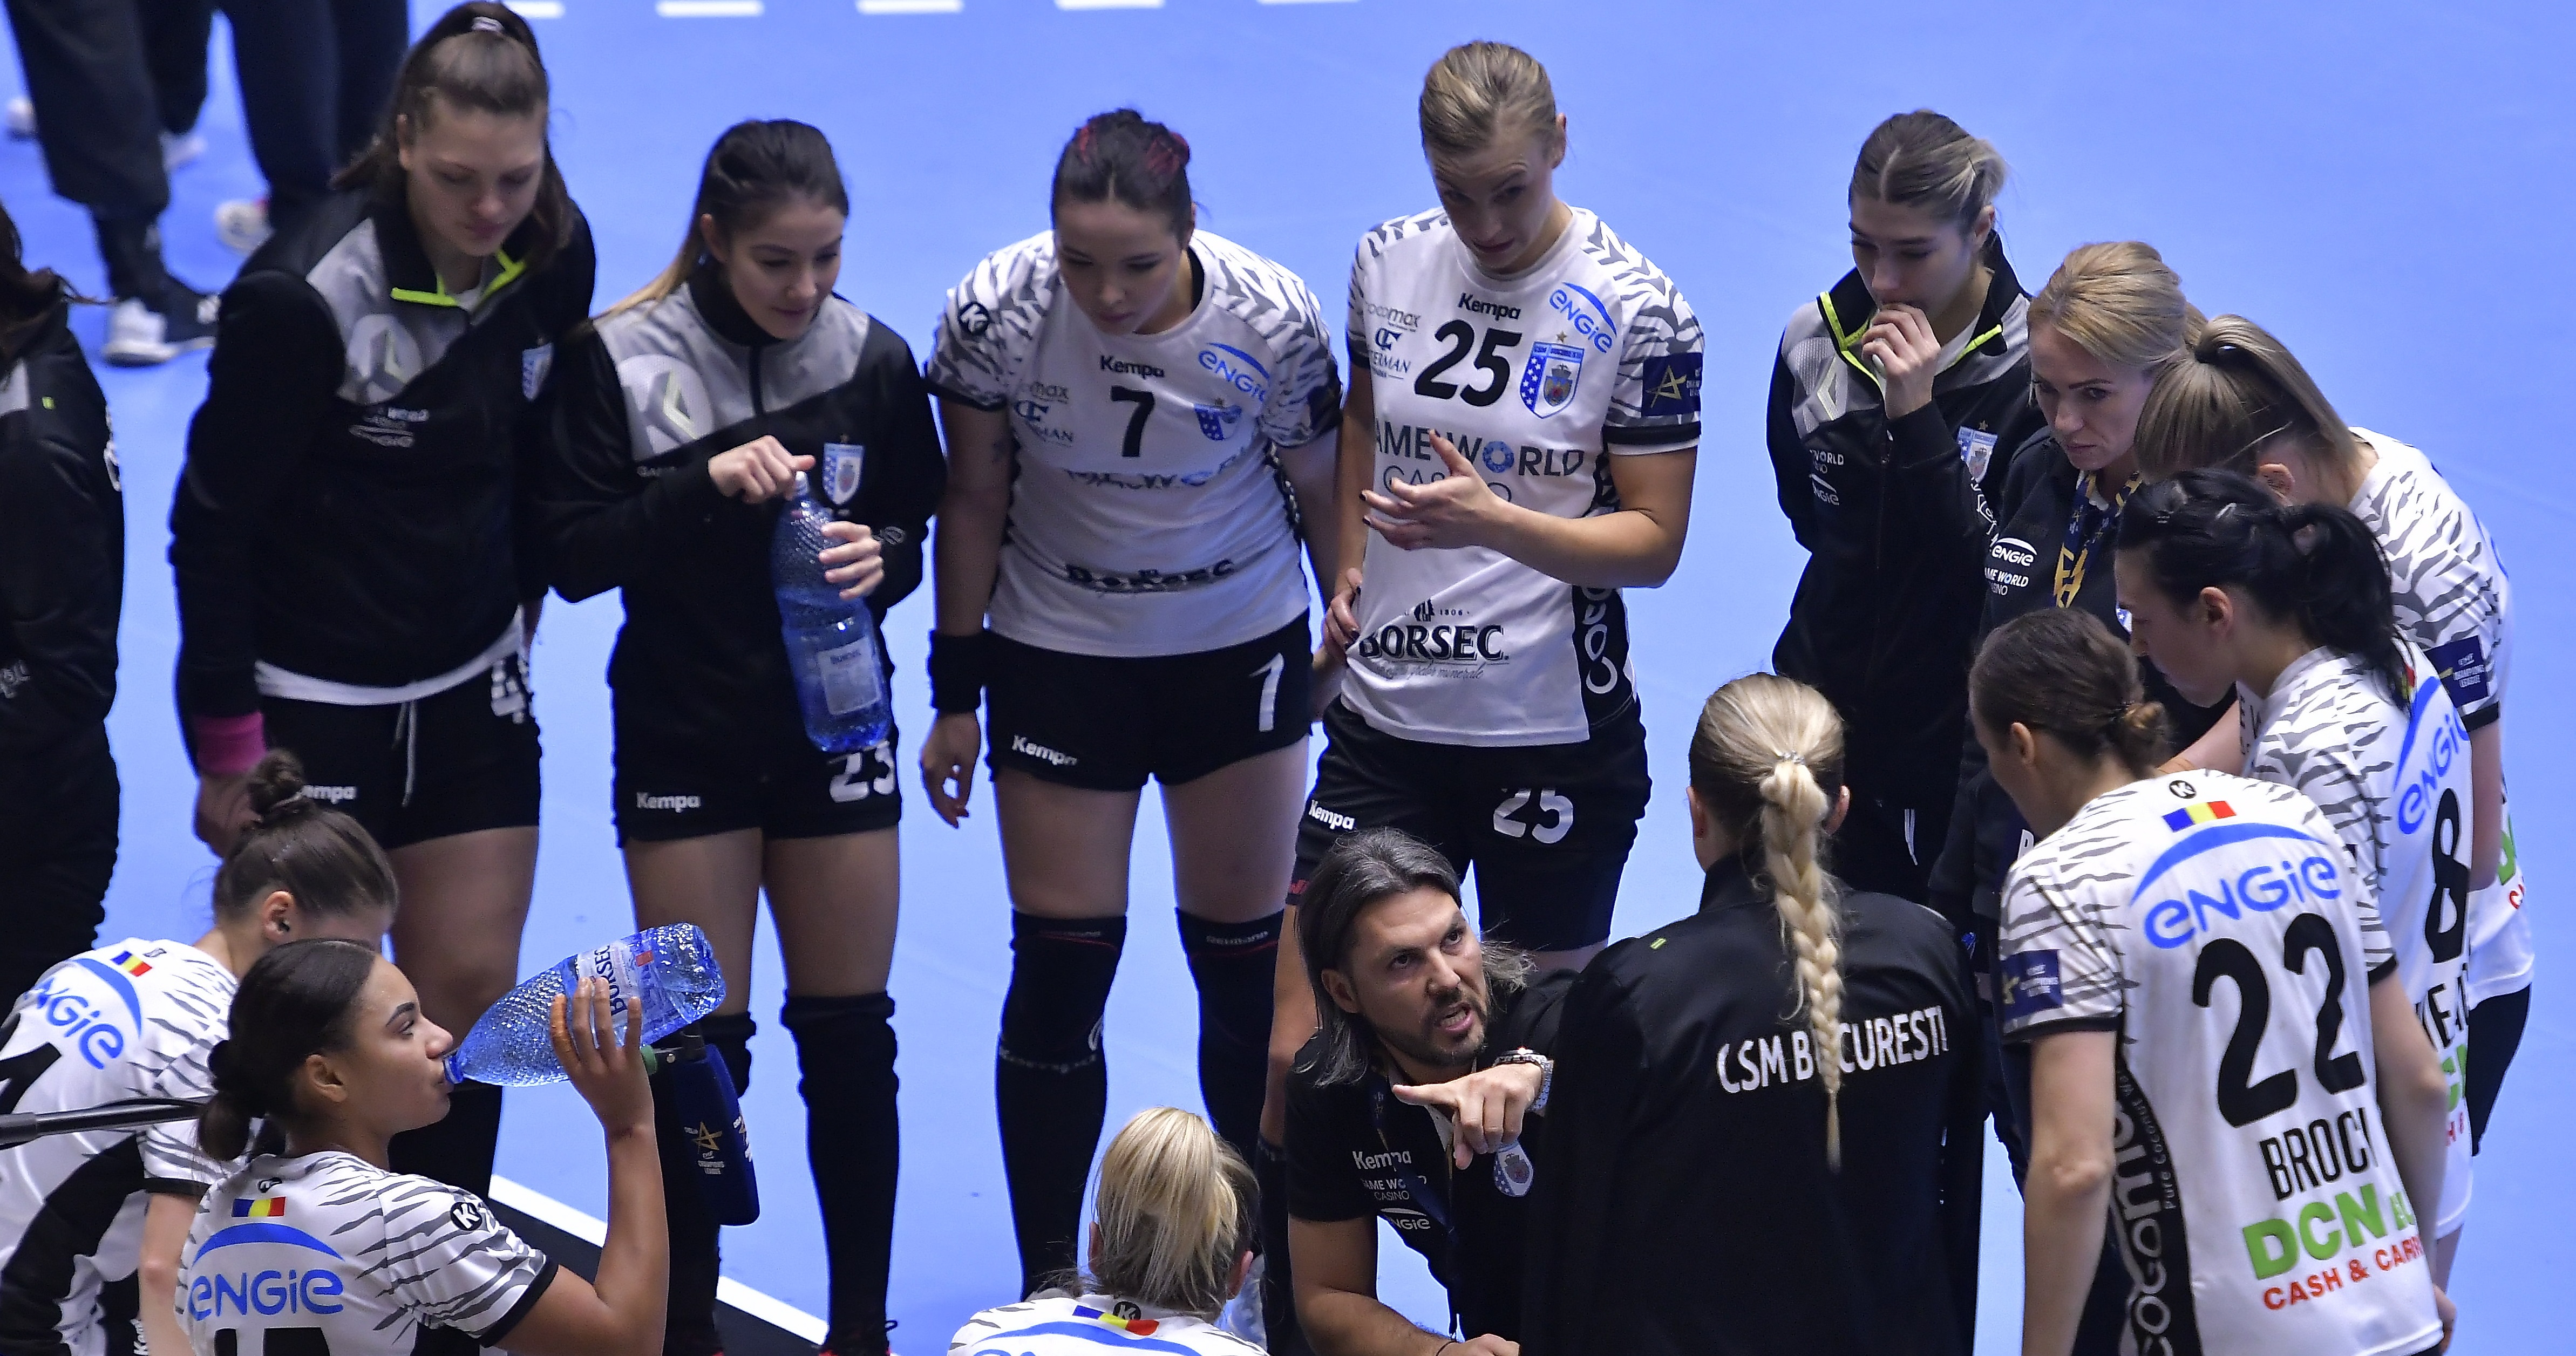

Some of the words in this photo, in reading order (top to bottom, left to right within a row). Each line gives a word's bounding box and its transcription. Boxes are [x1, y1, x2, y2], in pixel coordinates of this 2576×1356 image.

[1458, 293, 1521, 321] Kempa
[1099, 355, 1165, 379] Kempa
[1414, 319, 1522, 407] 25
[1110, 385, 1156, 458] 7
[1376, 421, 1432, 461] AME
[1446, 432, 1585, 476] WORLD
[1997, 570, 2029, 588] WORLD
[1011, 734, 1078, 767] Kempa
[636, 792, 702, 813] Kempa
[1309, 799, 1356, 830] Kempa
[1493, 788, 1574, 844] 25
[2424, 787, 2471, 964] 8
[2192, 912, 2365, 1129] 22
[1716, 1035, 1789, 1094] CSM
[1374, 1190, 1410, 1201] CASINO
[2242, 1183, 2388, 1280] DCN
[2263, 1267, 2345, 1311] CASH
[2348, 1258, 2371, 1283] &
